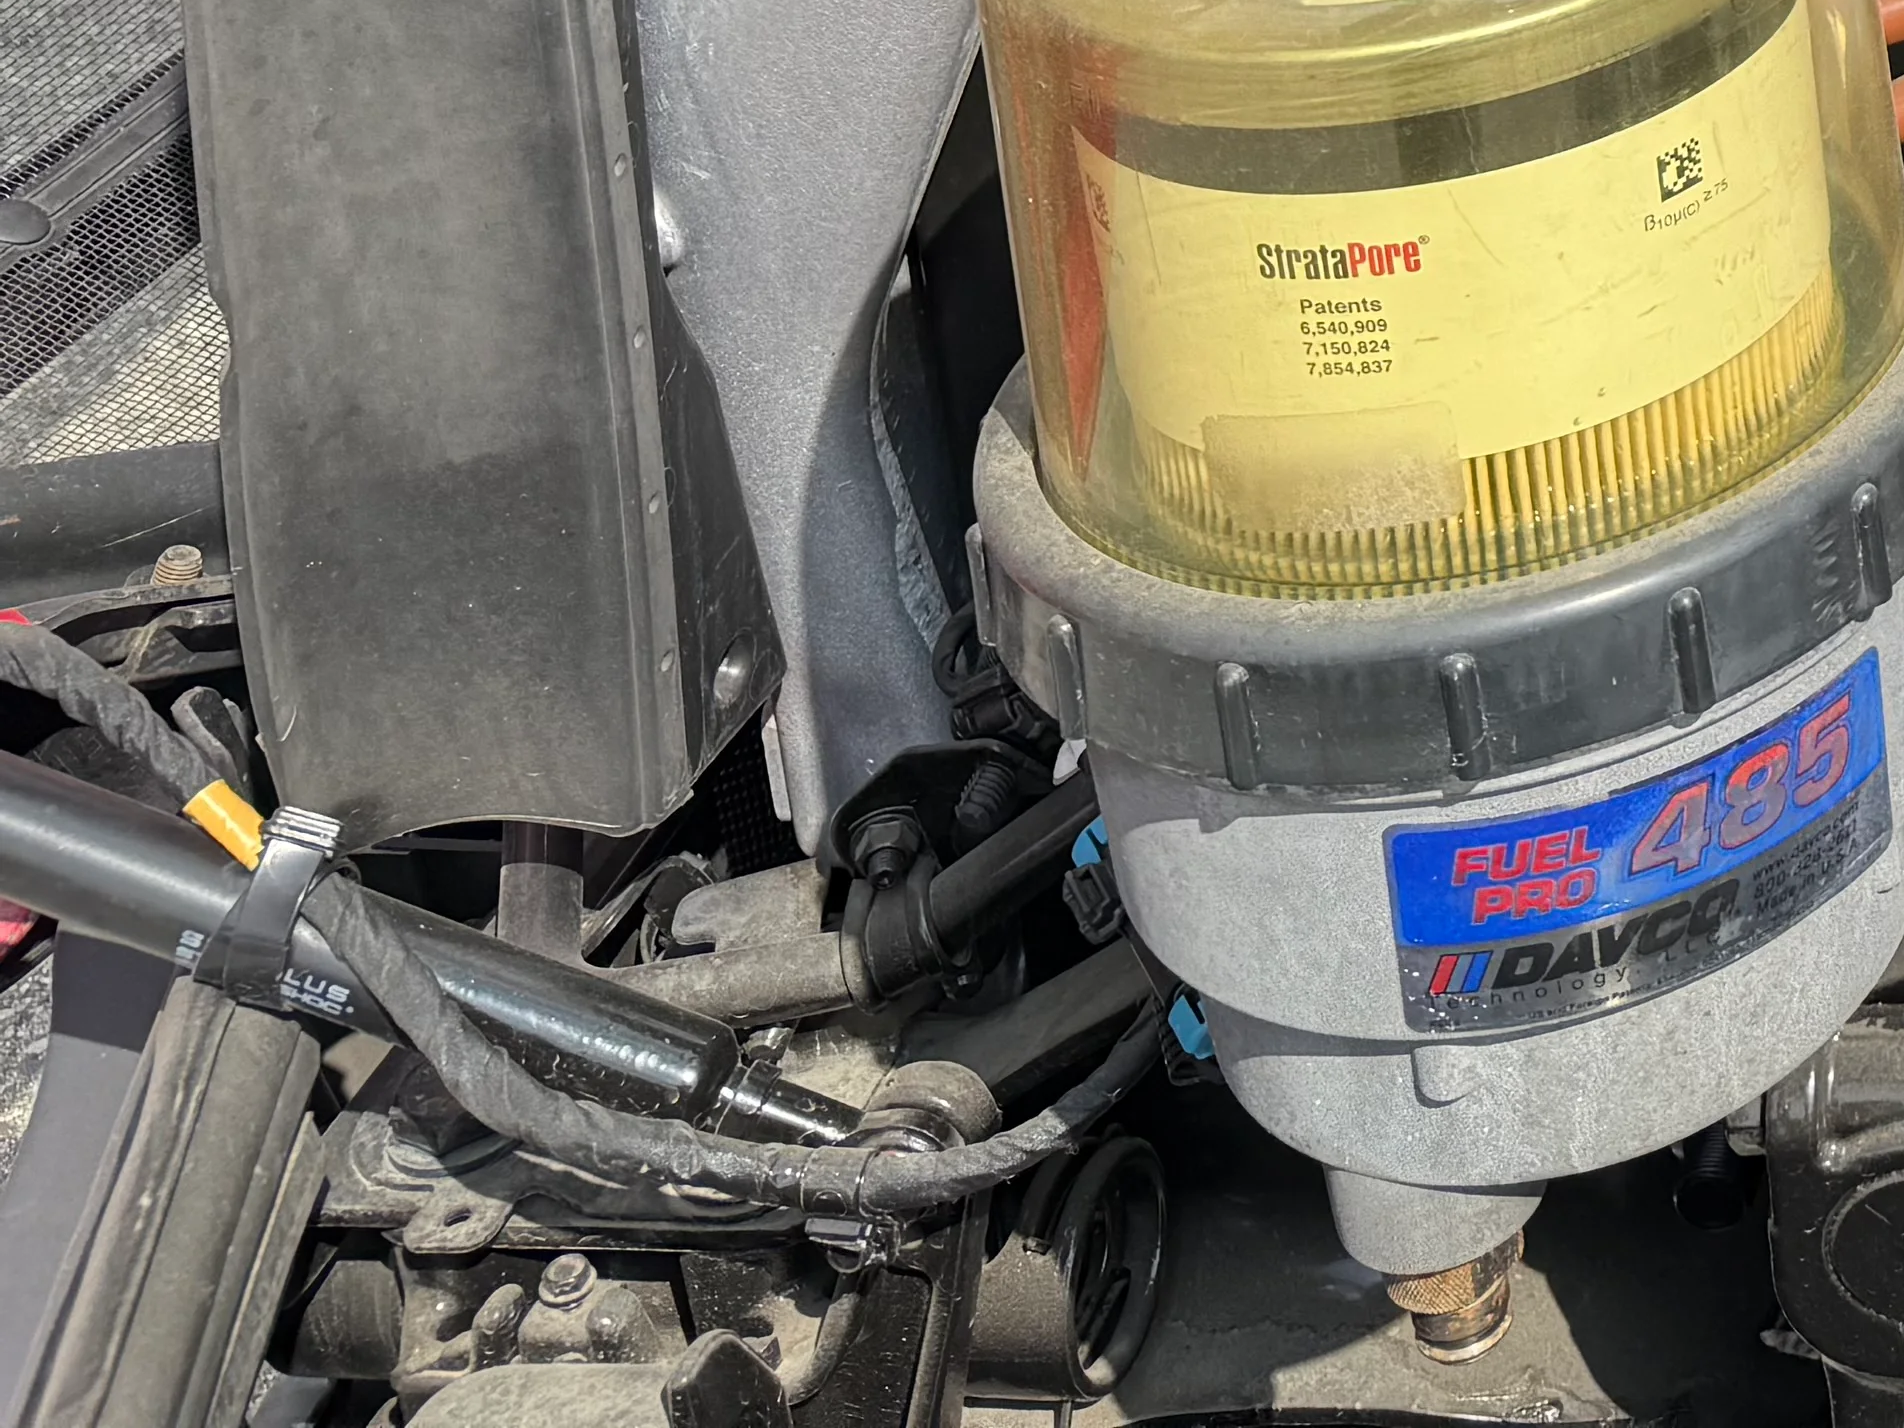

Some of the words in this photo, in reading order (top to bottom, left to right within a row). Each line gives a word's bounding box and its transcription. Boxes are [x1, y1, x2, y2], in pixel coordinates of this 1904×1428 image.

[1257, 234, 1422, 282] StrataPore
[1299, 317, 1389, 338] 6,540,909
[1300, 296, 1382, 316] Patents
[1302, 338, 1391, 359] 7,150,824
[1306, 358, 1394, 378] 7,854,837
[1626, 689, 1854, 880] 485
[1451, 826, 1603, 888] FUEL
[1470, 865, 1600, 928] PRO
[1490, 878, 1742, 991] DAVCO
[1424, 963, 1628, 1012] Technology
